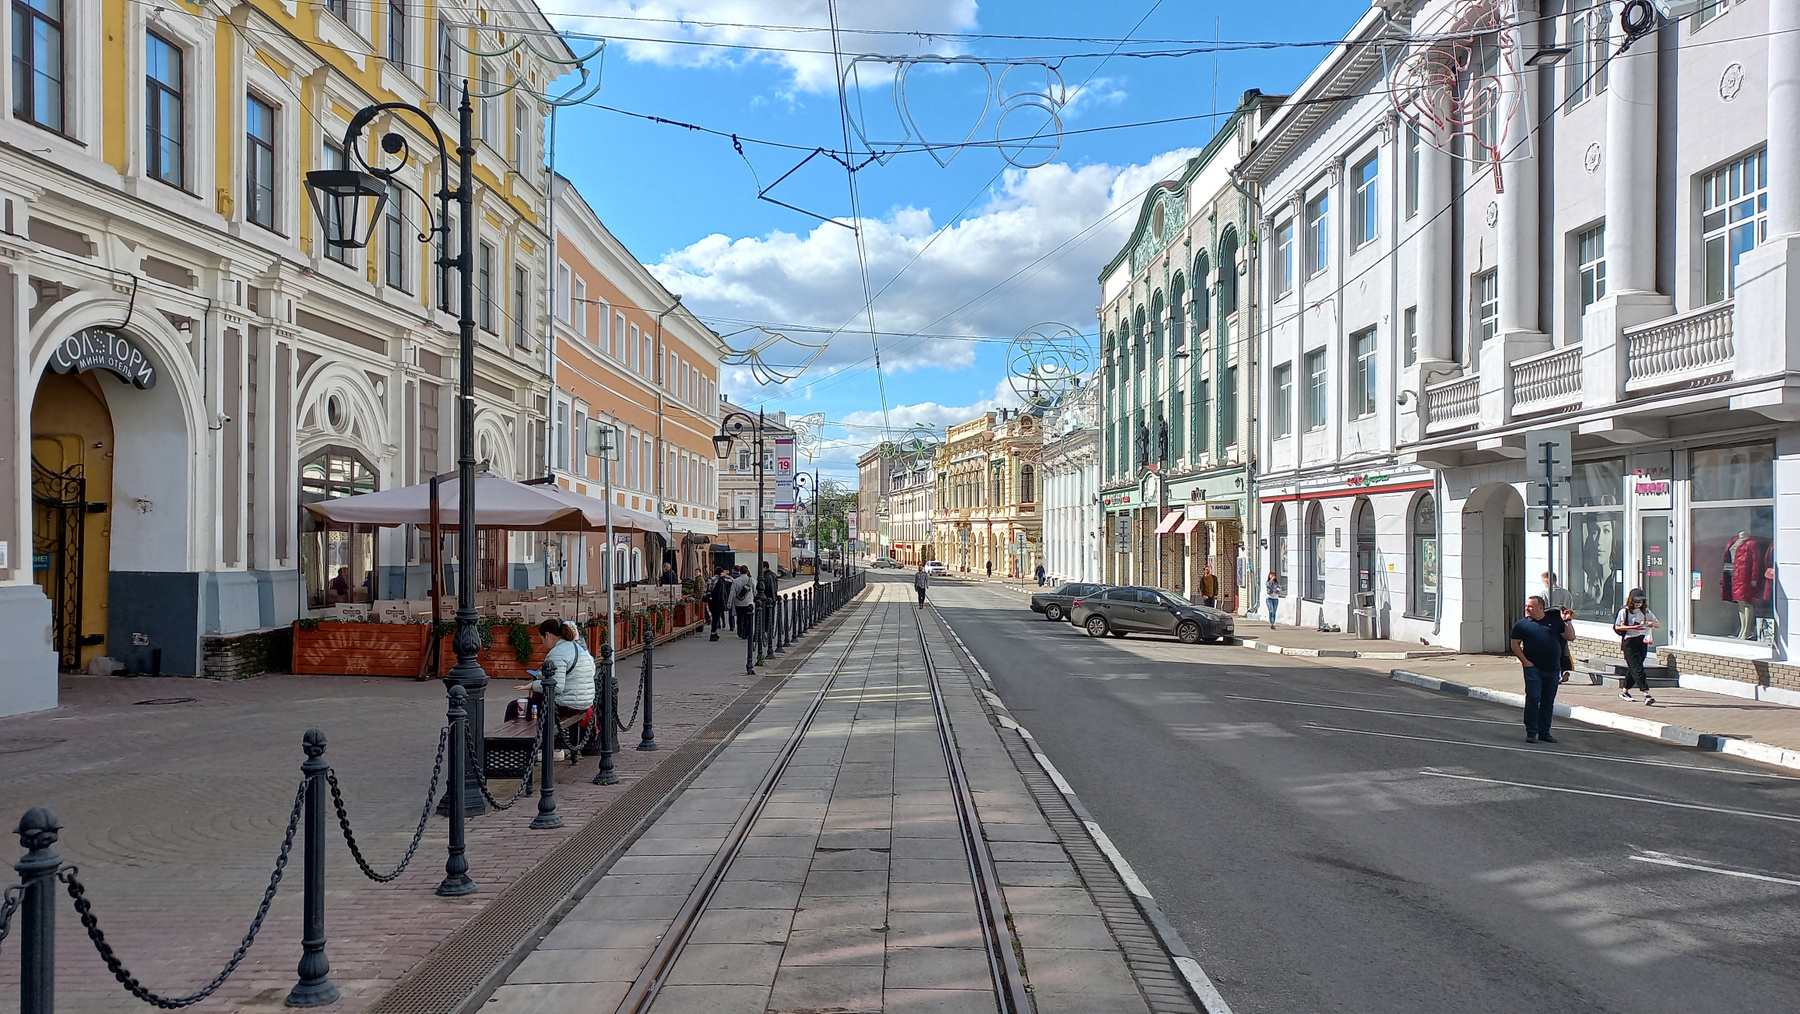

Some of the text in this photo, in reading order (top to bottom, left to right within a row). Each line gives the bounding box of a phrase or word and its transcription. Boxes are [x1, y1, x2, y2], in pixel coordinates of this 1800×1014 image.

[79, 355, 132, 378] МИНИ ОТЕЛЬ
[778, 461, 791, 470] 19
